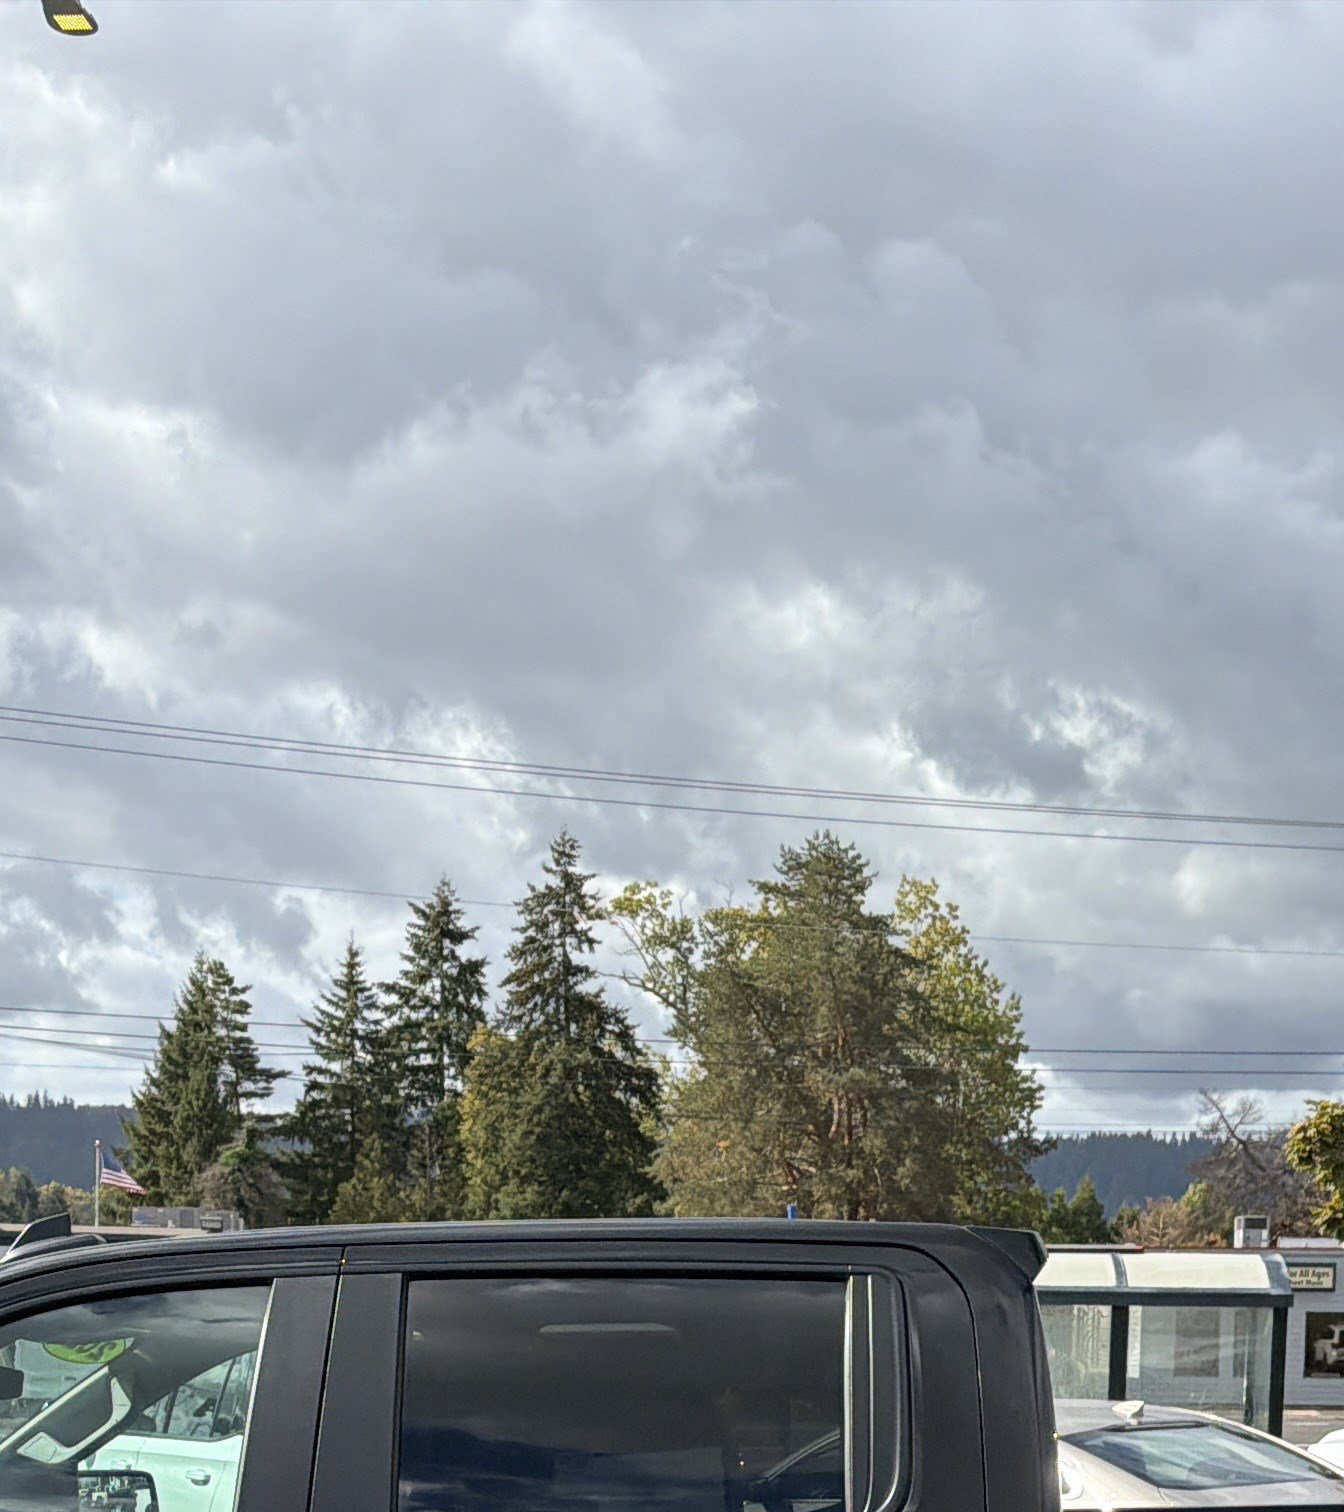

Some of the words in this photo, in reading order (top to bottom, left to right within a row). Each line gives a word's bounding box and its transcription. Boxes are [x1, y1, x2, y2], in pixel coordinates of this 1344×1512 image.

[1287, 1269, 1298, 1278] or
[1299, 1269, 1310, 1278] All
[1311, 1269, 1330, 1281] Ages
